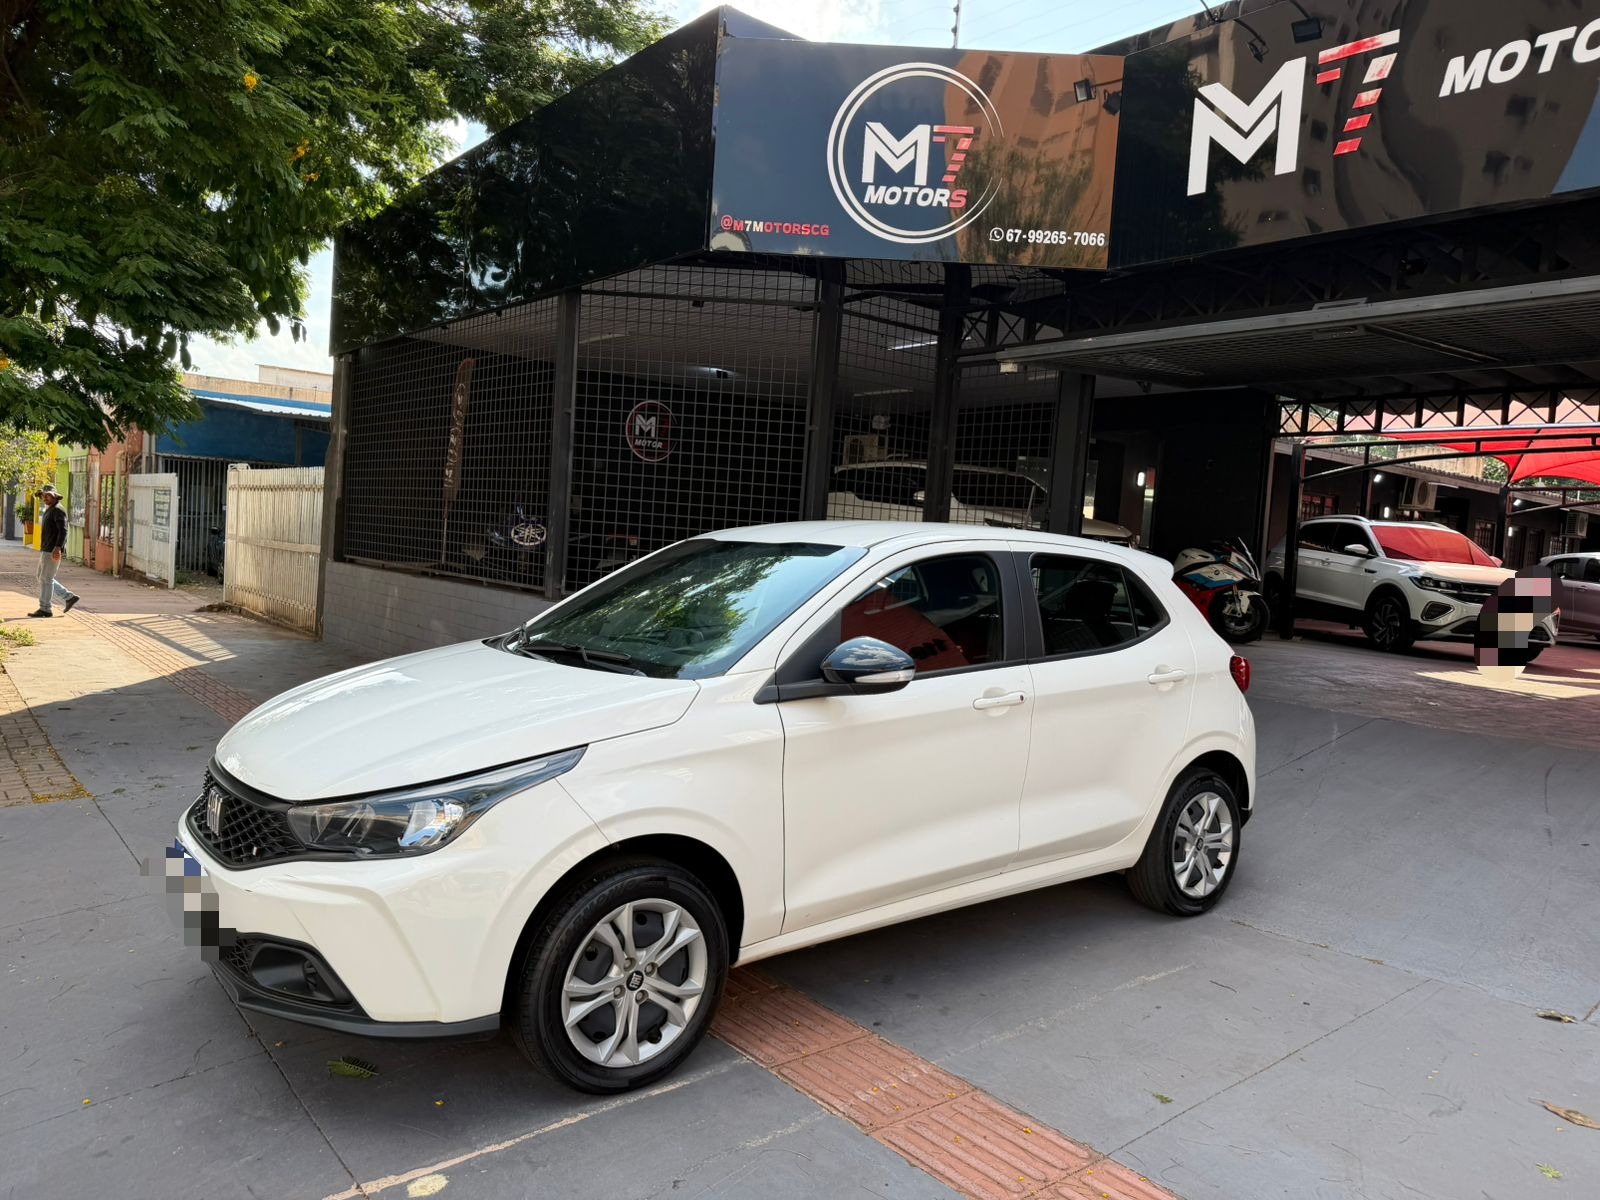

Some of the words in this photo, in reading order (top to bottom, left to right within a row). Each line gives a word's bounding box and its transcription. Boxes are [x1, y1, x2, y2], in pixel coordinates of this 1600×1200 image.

[1187, 29, 1401, 197] M7
[862, 121, 974, 186] M7
[863, 184, 968, 208] MOTORS
[720, 214, 830, 236] @M7MOTORSCG
[1005, 228, 1106, 247] 67-99265-7066
